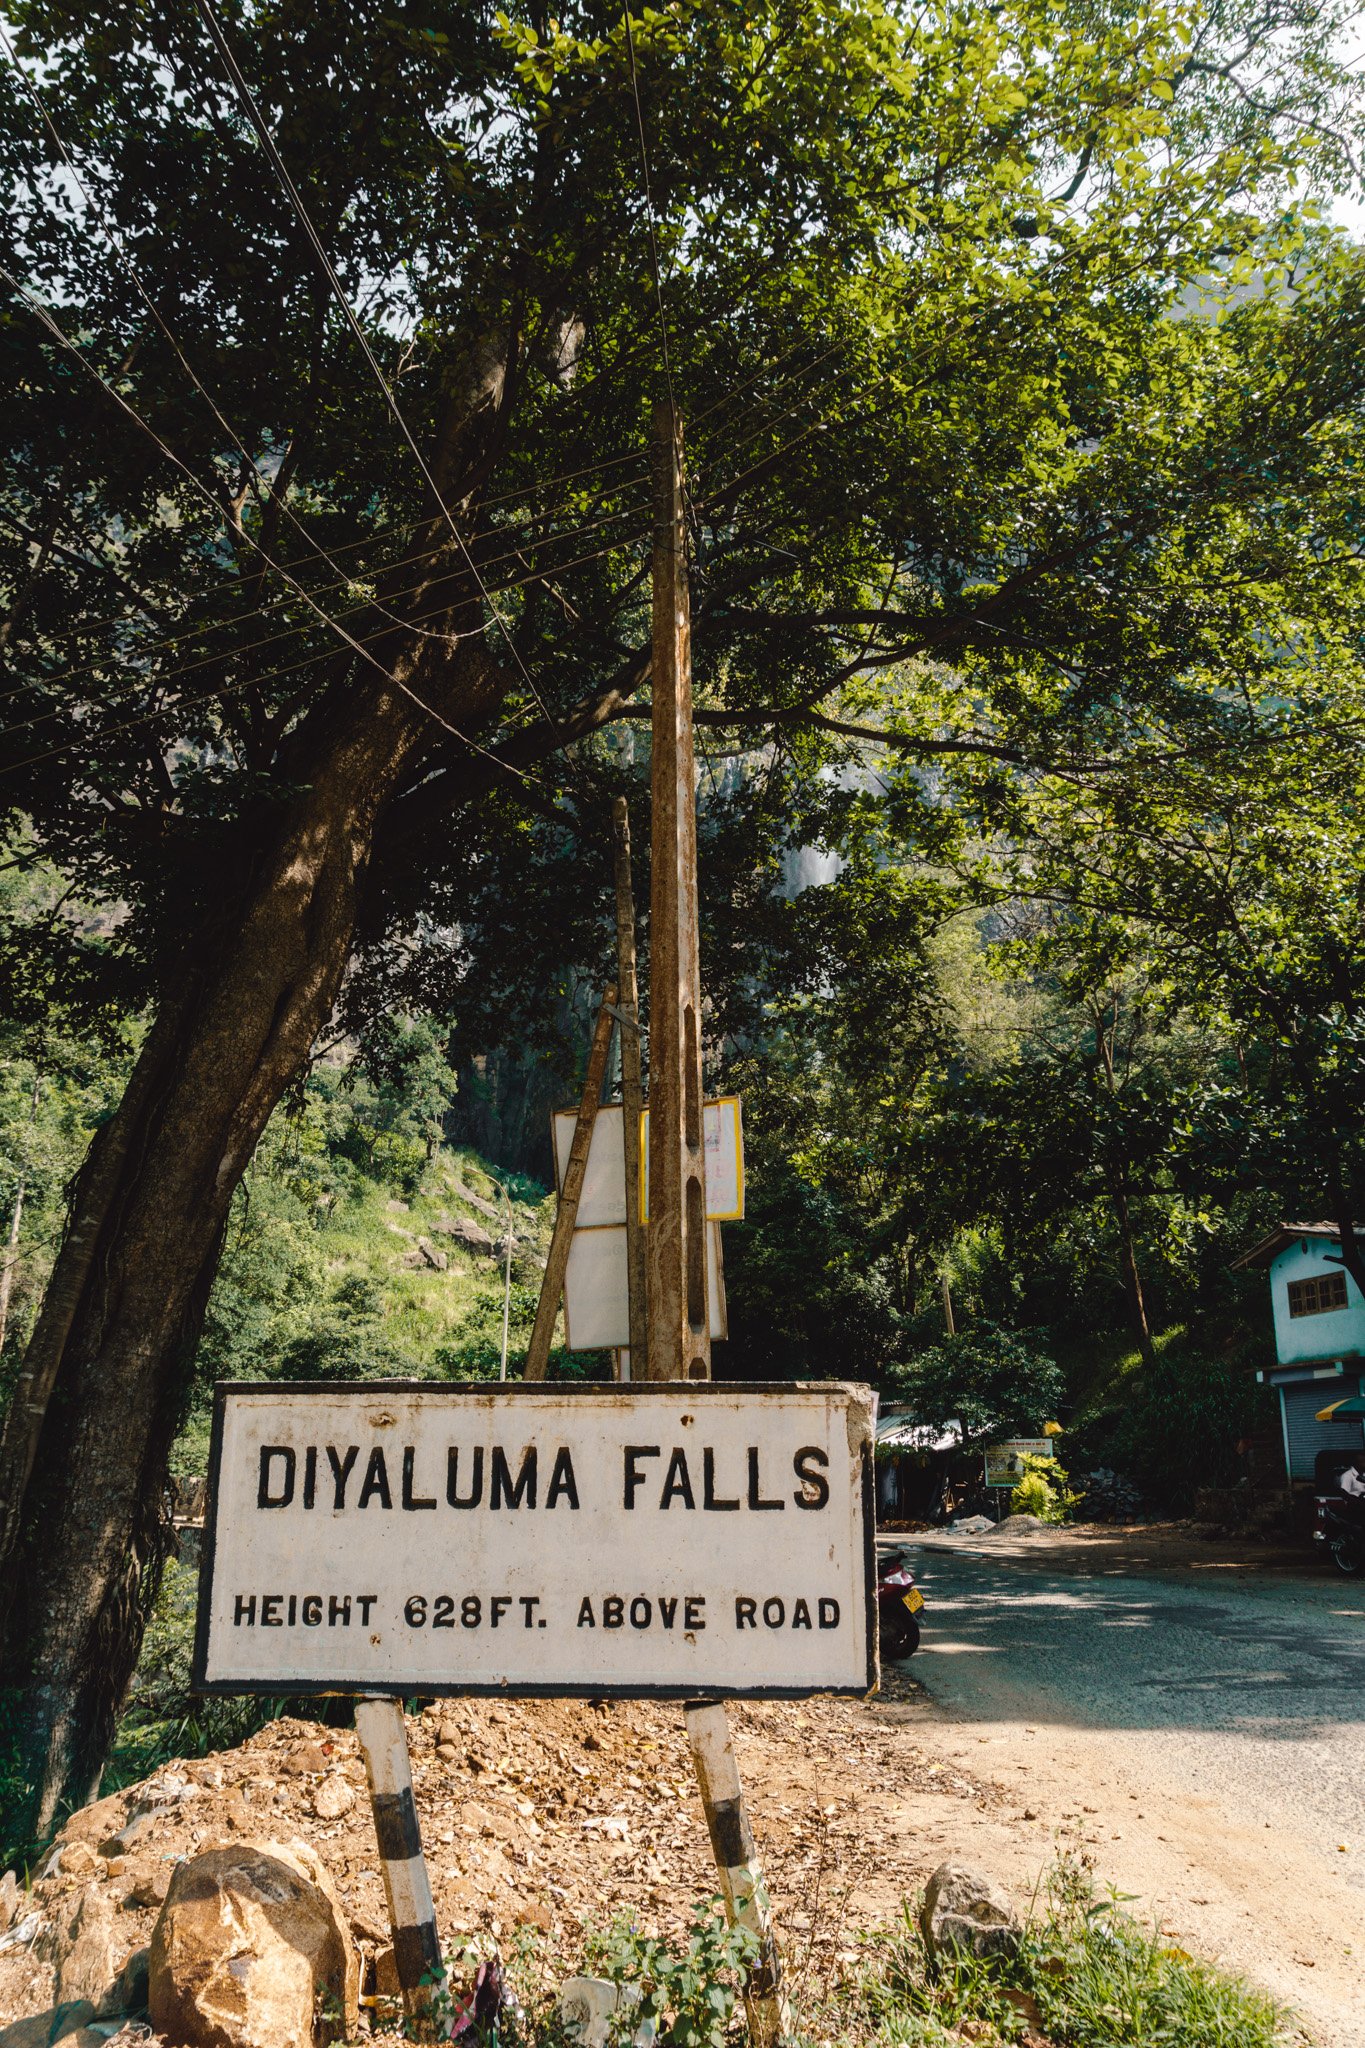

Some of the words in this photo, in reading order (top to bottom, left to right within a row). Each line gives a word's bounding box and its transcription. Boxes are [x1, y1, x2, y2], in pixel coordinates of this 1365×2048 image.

[256, 1444, 580, 1511] DIYALUMA
[623, 1444, 830, 1512] FALLS
[233, 1594, 378, 1628] HEIGHT
[576, 1594, 706, 1631] ABOVE
[735, 1596, 841, 1630] ROAD
